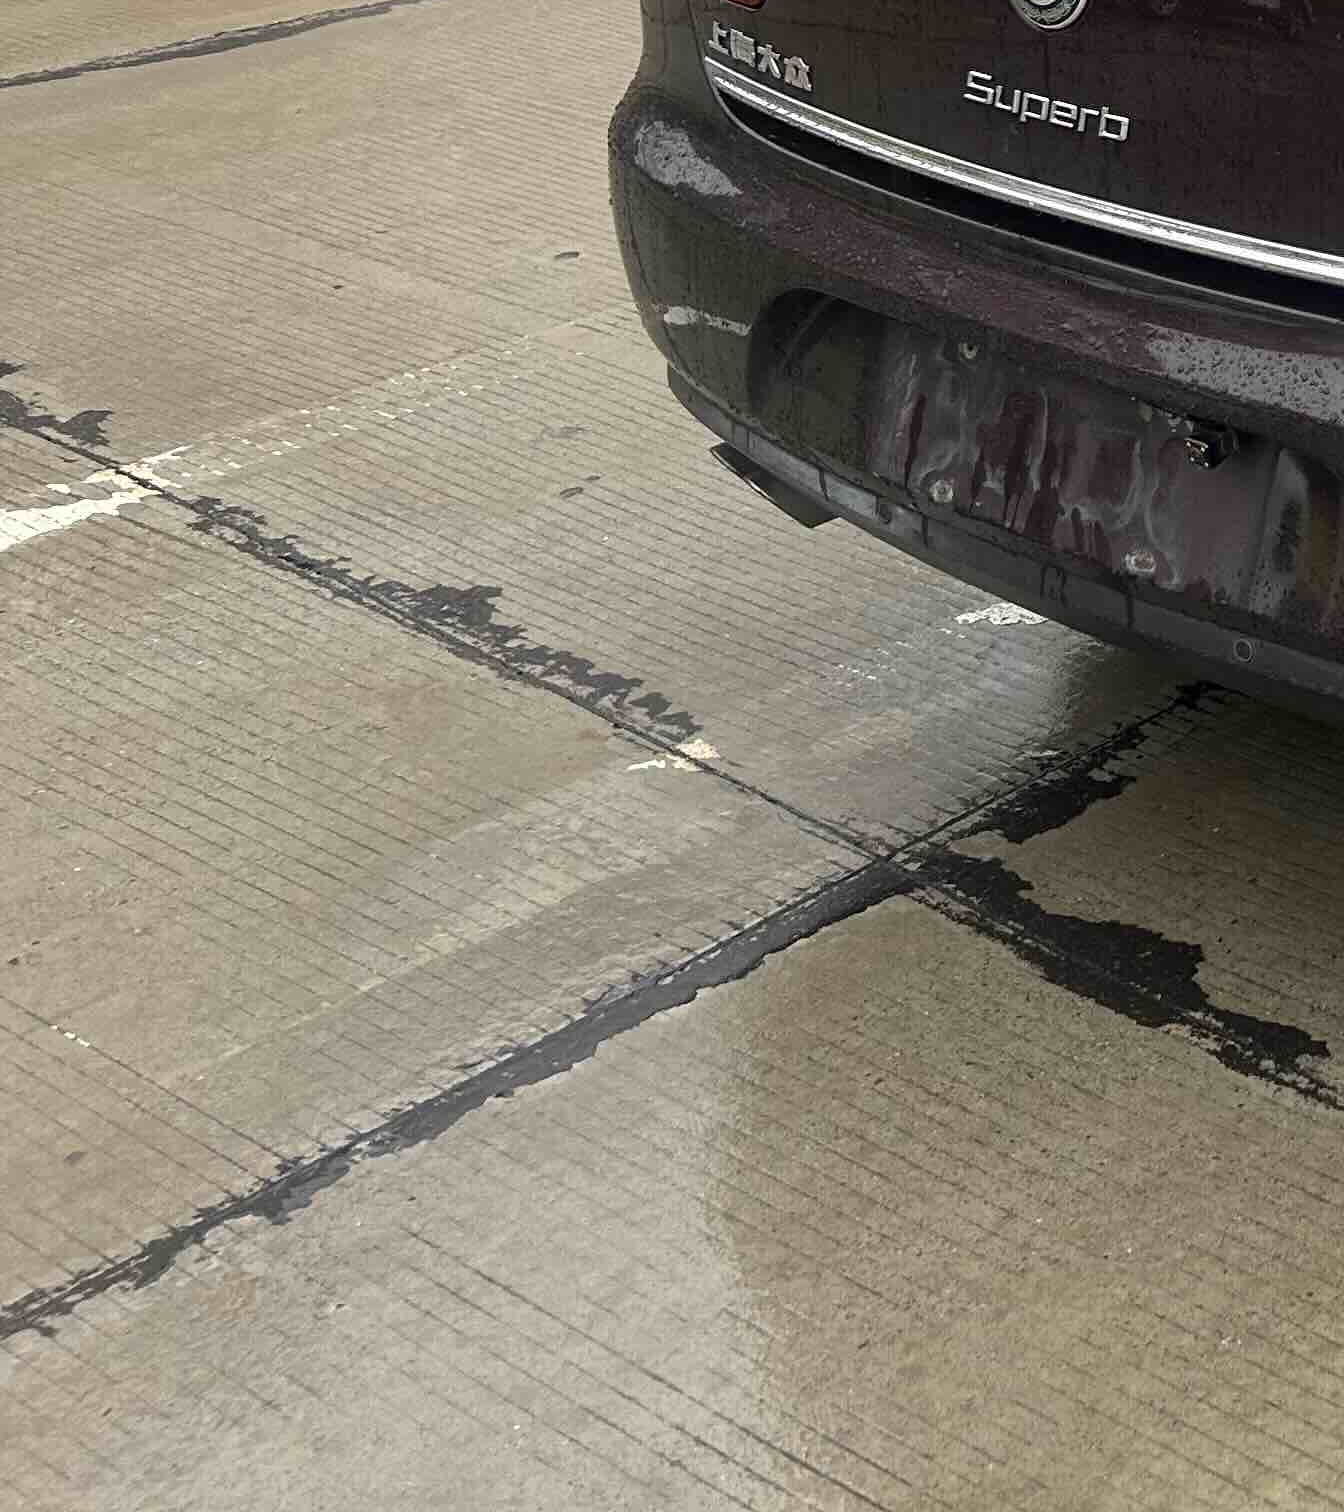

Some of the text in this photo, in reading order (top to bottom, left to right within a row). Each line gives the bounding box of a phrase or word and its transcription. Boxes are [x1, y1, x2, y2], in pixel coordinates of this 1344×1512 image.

[708, 20, 813, 93] 上海大众
[963, 70, 1130, 142] Superb
